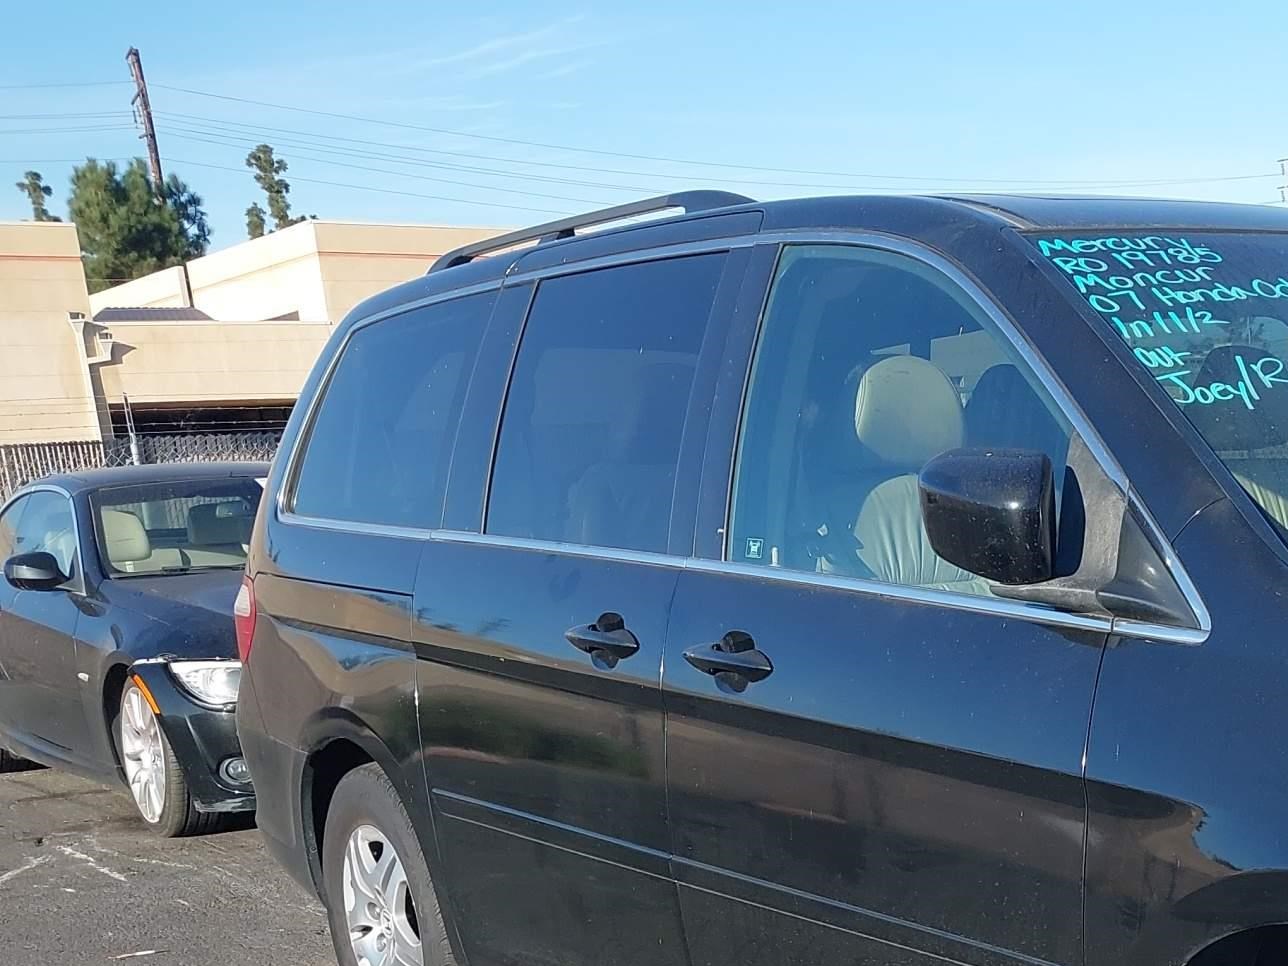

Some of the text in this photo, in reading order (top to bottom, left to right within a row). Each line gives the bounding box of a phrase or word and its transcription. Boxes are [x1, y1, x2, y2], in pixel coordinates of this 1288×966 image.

[1052, 257, 1108, 274] RO
[1089, 290, 1146, 313] 07
[1152, 282, 1252, 306] Honda
[1152, 306, 1231, 335] 11/2
